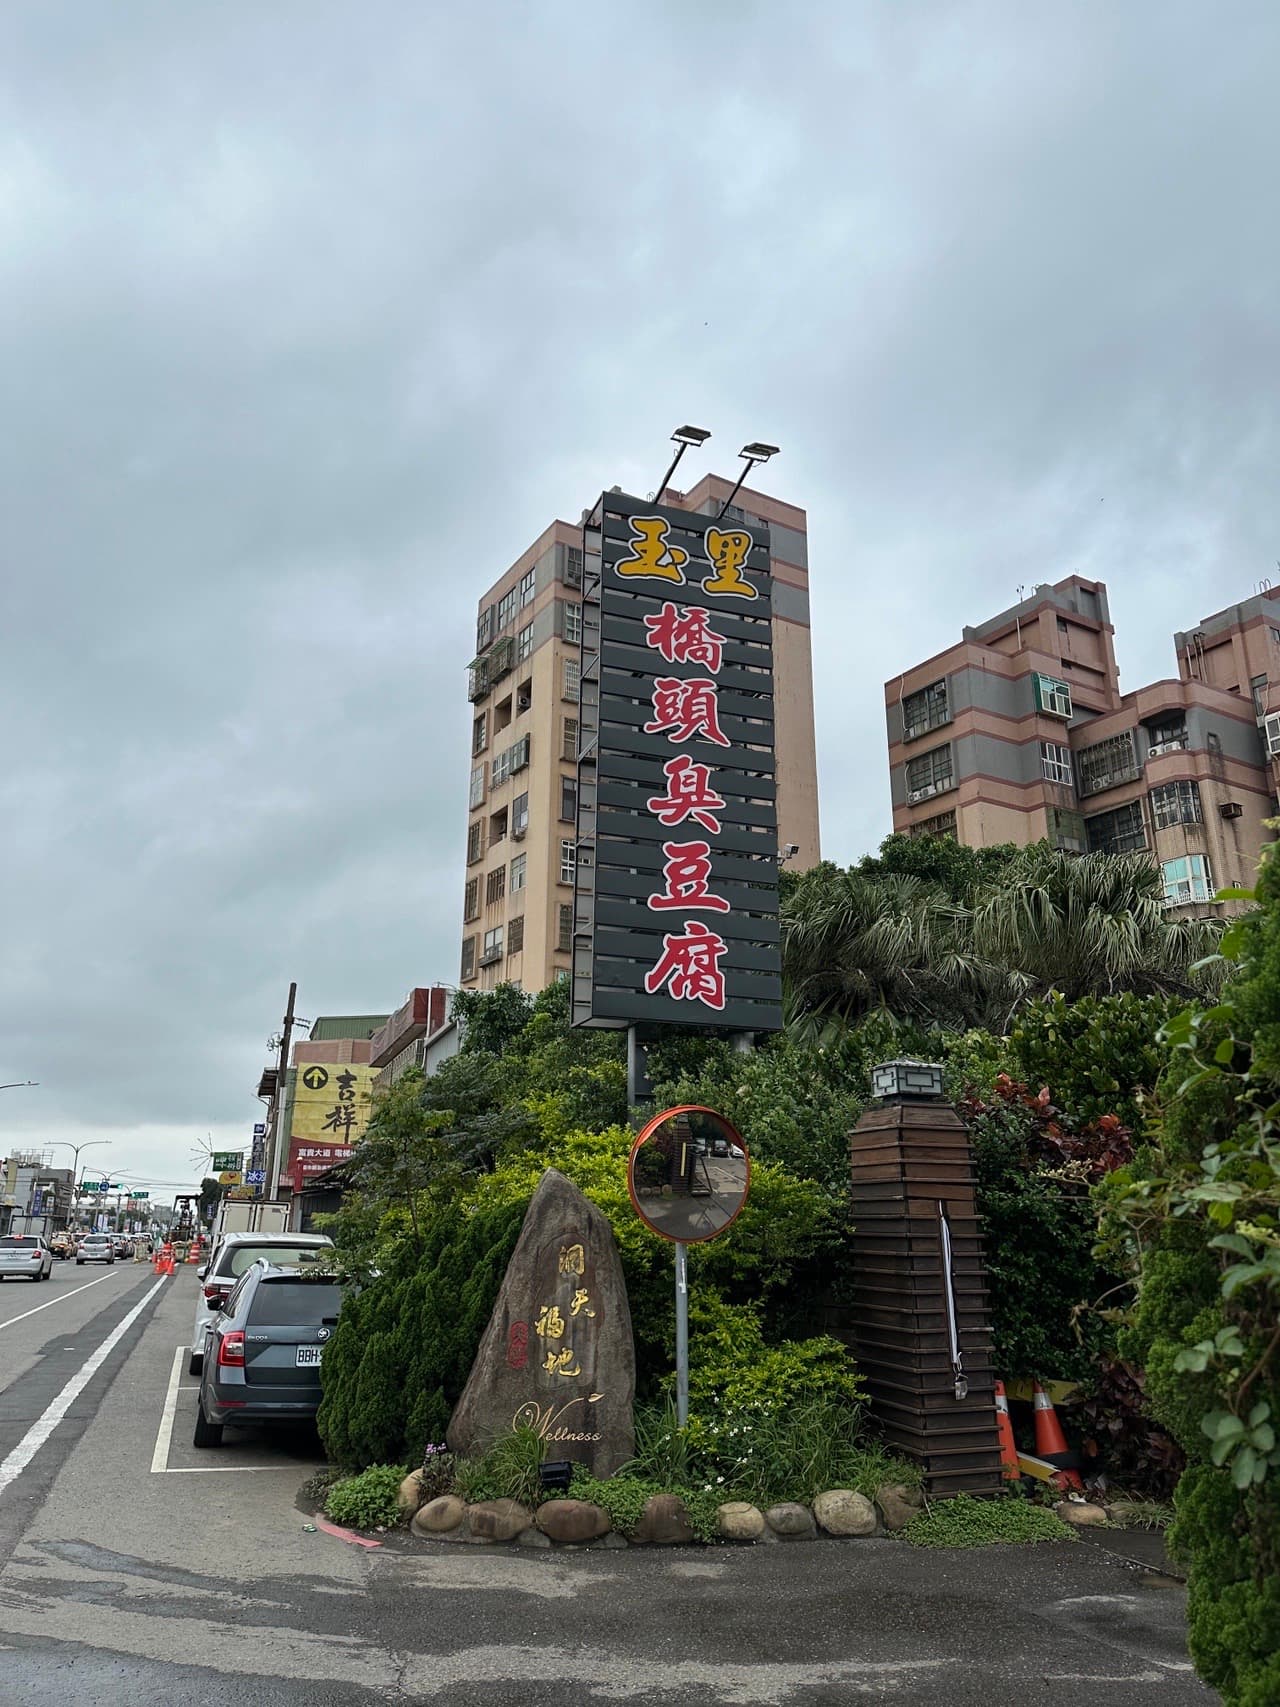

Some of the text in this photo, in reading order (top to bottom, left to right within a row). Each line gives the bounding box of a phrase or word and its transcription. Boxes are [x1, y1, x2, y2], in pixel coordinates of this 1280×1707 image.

[614, 516, 758, 600] 玉里
[643, 602, 732, 1011] 橋頭臭豆腐
[321, 1068, 358, 1145] 吉祥
[298, 1349, 323, 1363] BBH-
[513, 1397, 602, 1441] Wellness
